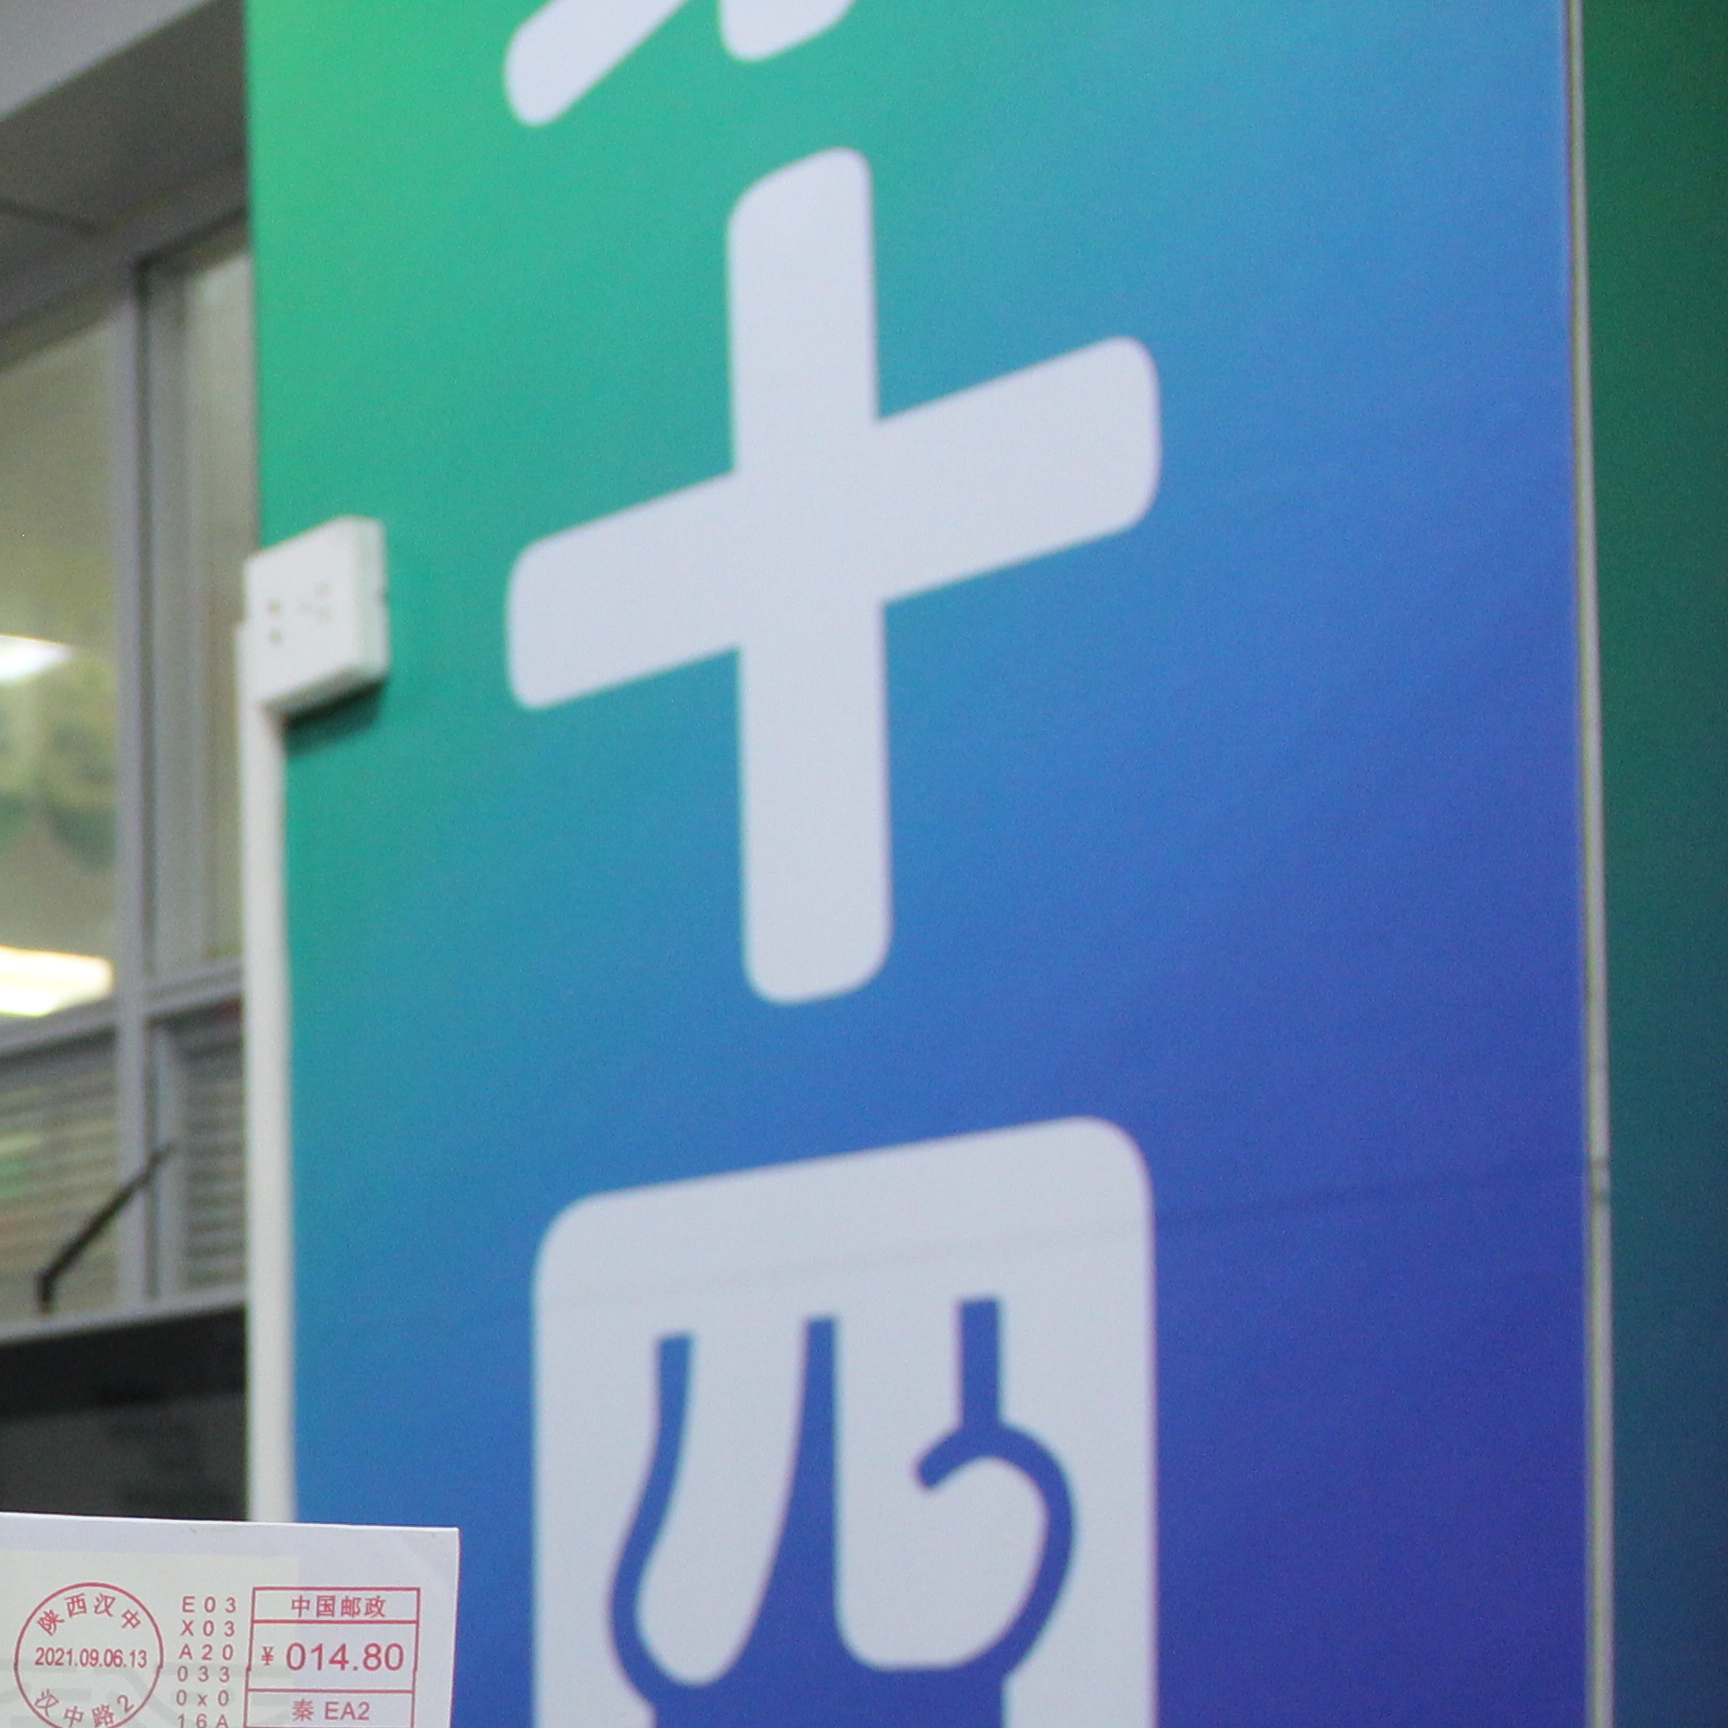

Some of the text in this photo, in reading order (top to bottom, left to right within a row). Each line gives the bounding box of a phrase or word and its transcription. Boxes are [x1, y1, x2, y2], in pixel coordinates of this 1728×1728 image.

[37, 1593, 142, 1636] 陕西汉中
[291, 1595, 387, 1618] 中国邮政
[34, 1646, 148, 1669] 2021.09.06.13
[34, 1689, 135, 1728] 汉中路2
[292, 1699, 370, 1722] 秦 EA2
